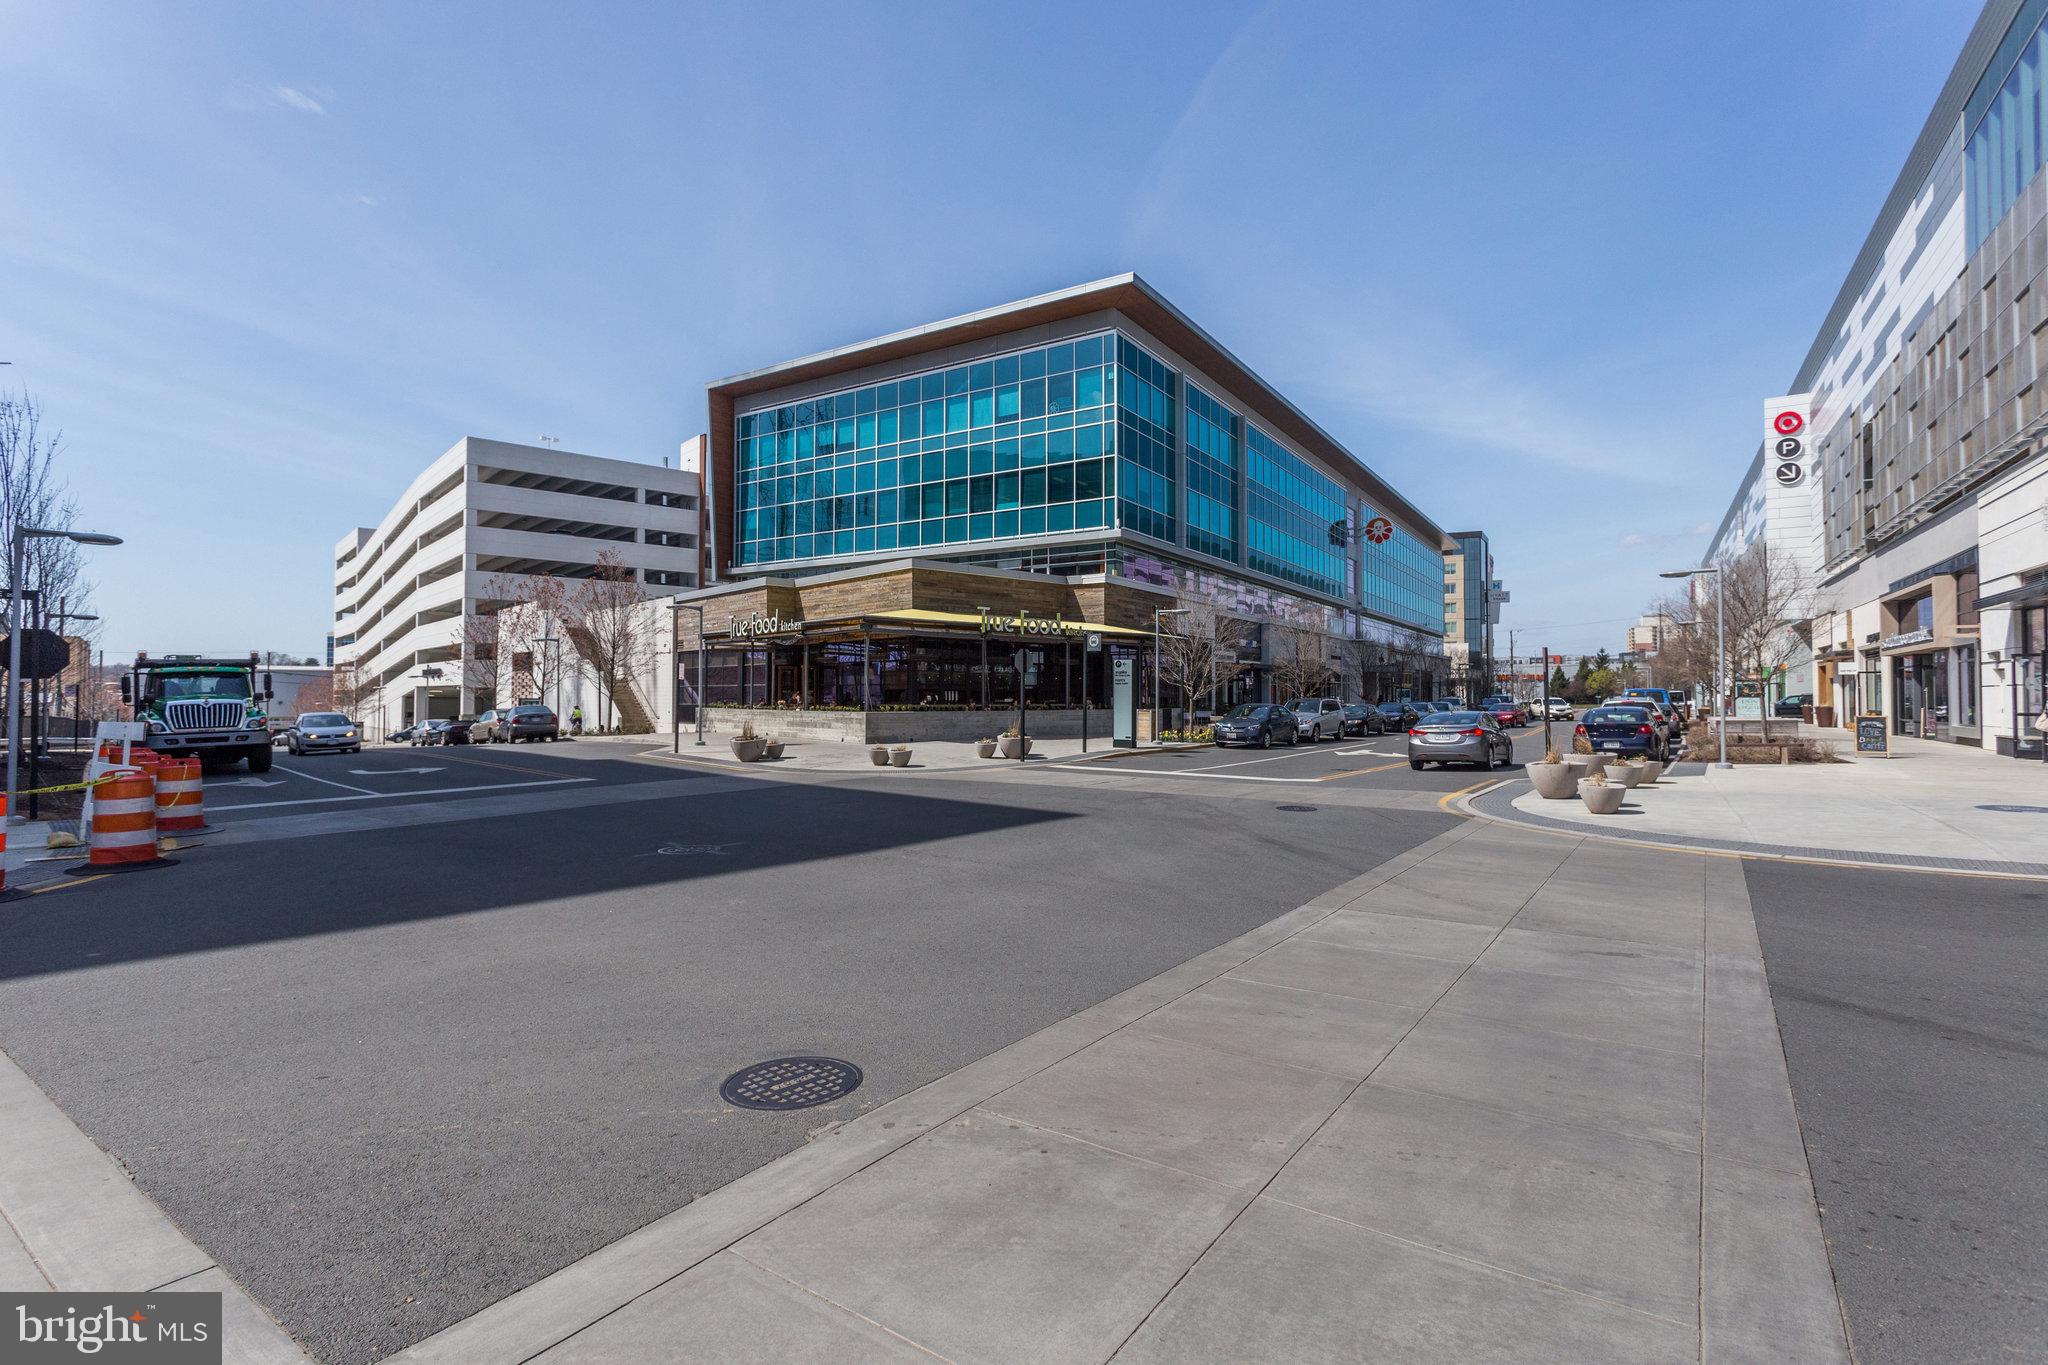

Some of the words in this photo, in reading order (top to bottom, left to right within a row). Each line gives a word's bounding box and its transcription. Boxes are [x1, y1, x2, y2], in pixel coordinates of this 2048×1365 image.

[1782, 441, 1796, 454] P
[728, 615, 748, 639] True
[752, 608, 778, 636] Food
[977, 606, 1015, 633] True
[1020, 609, 1062, 635] Food
